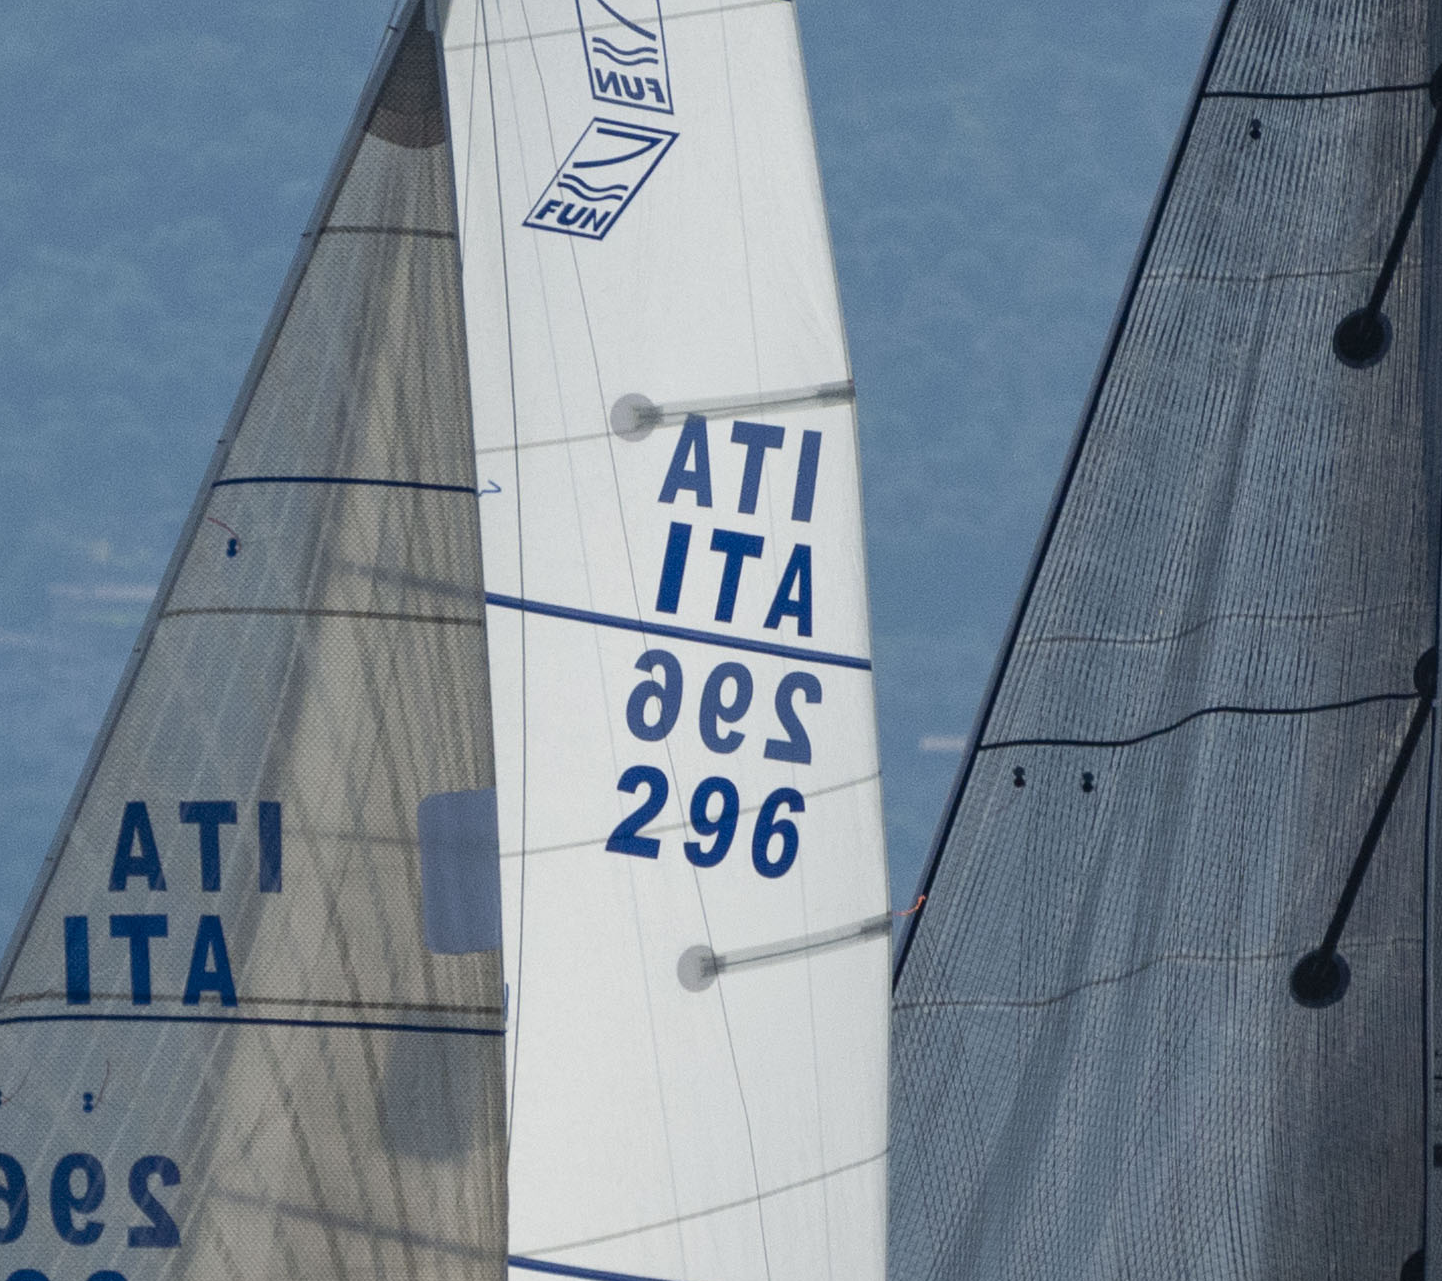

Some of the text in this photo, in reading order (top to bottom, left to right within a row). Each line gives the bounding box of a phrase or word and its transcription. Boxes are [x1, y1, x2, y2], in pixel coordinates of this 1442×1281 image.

[534, 199, 612, 233] FUN
[655, 521, 814, 638] ITA
[605, 764, 806, 879] 296
[62, 914, 239, 1008] ITA
